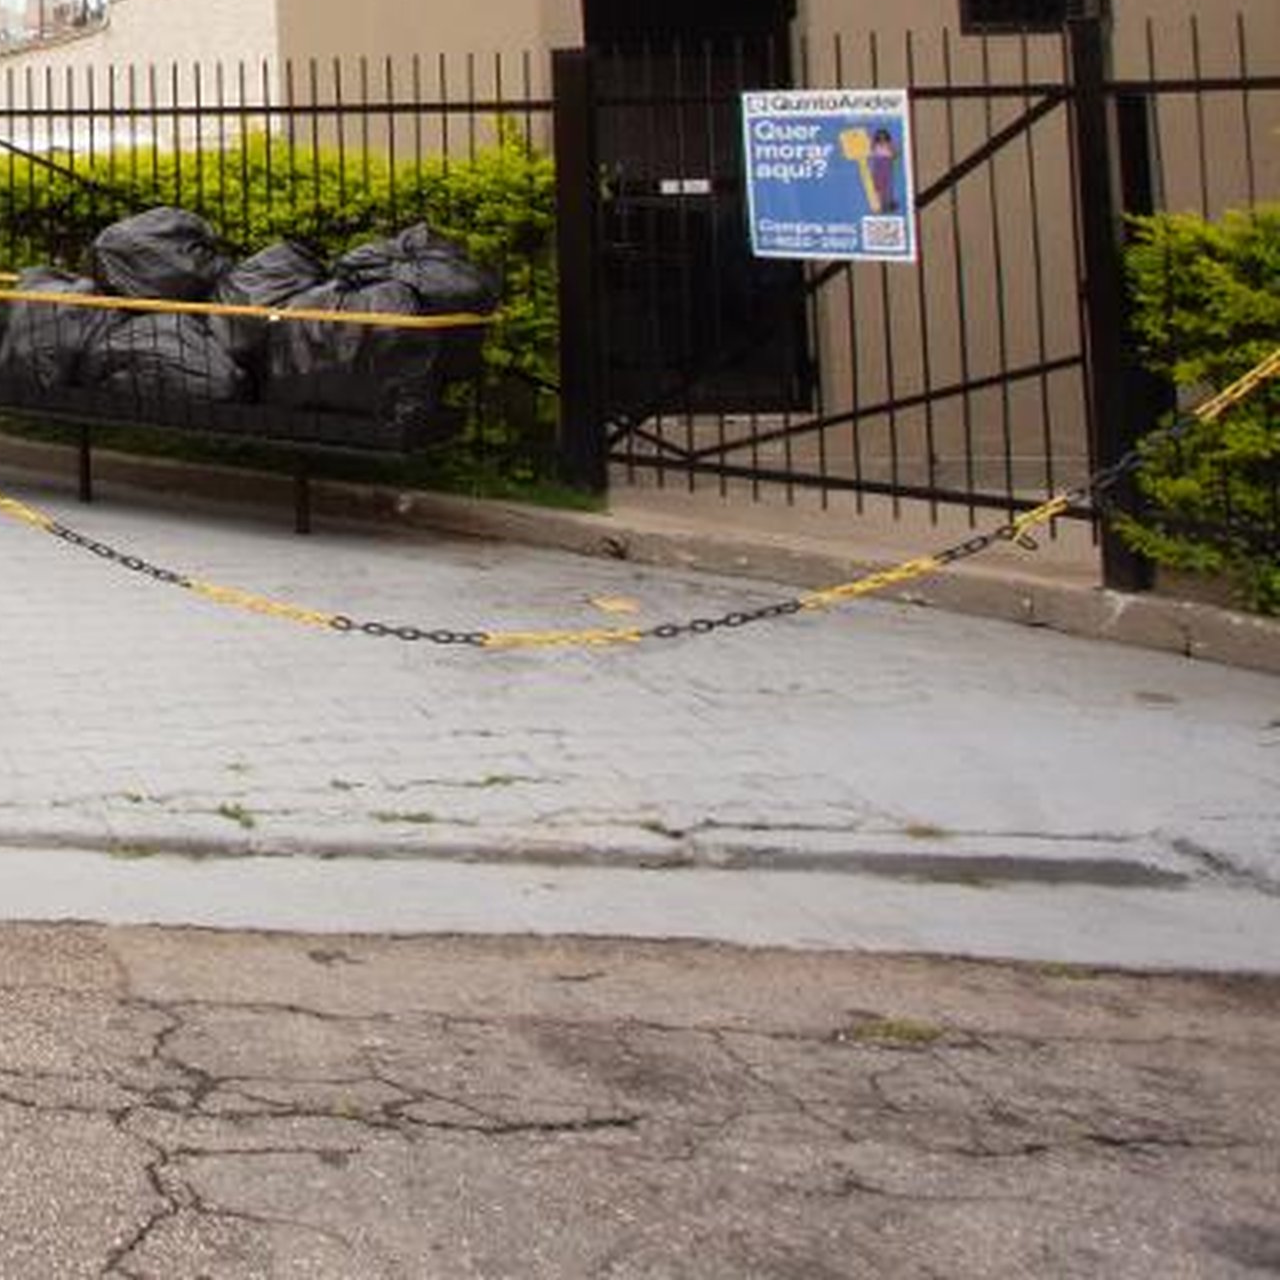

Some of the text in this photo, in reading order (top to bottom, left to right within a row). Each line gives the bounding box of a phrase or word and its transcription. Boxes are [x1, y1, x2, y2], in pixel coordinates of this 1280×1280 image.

[755, 119, 821, 140] Quer
[756, 144, 834, 160] morar
[757, 160, 829, 183] aqui?
